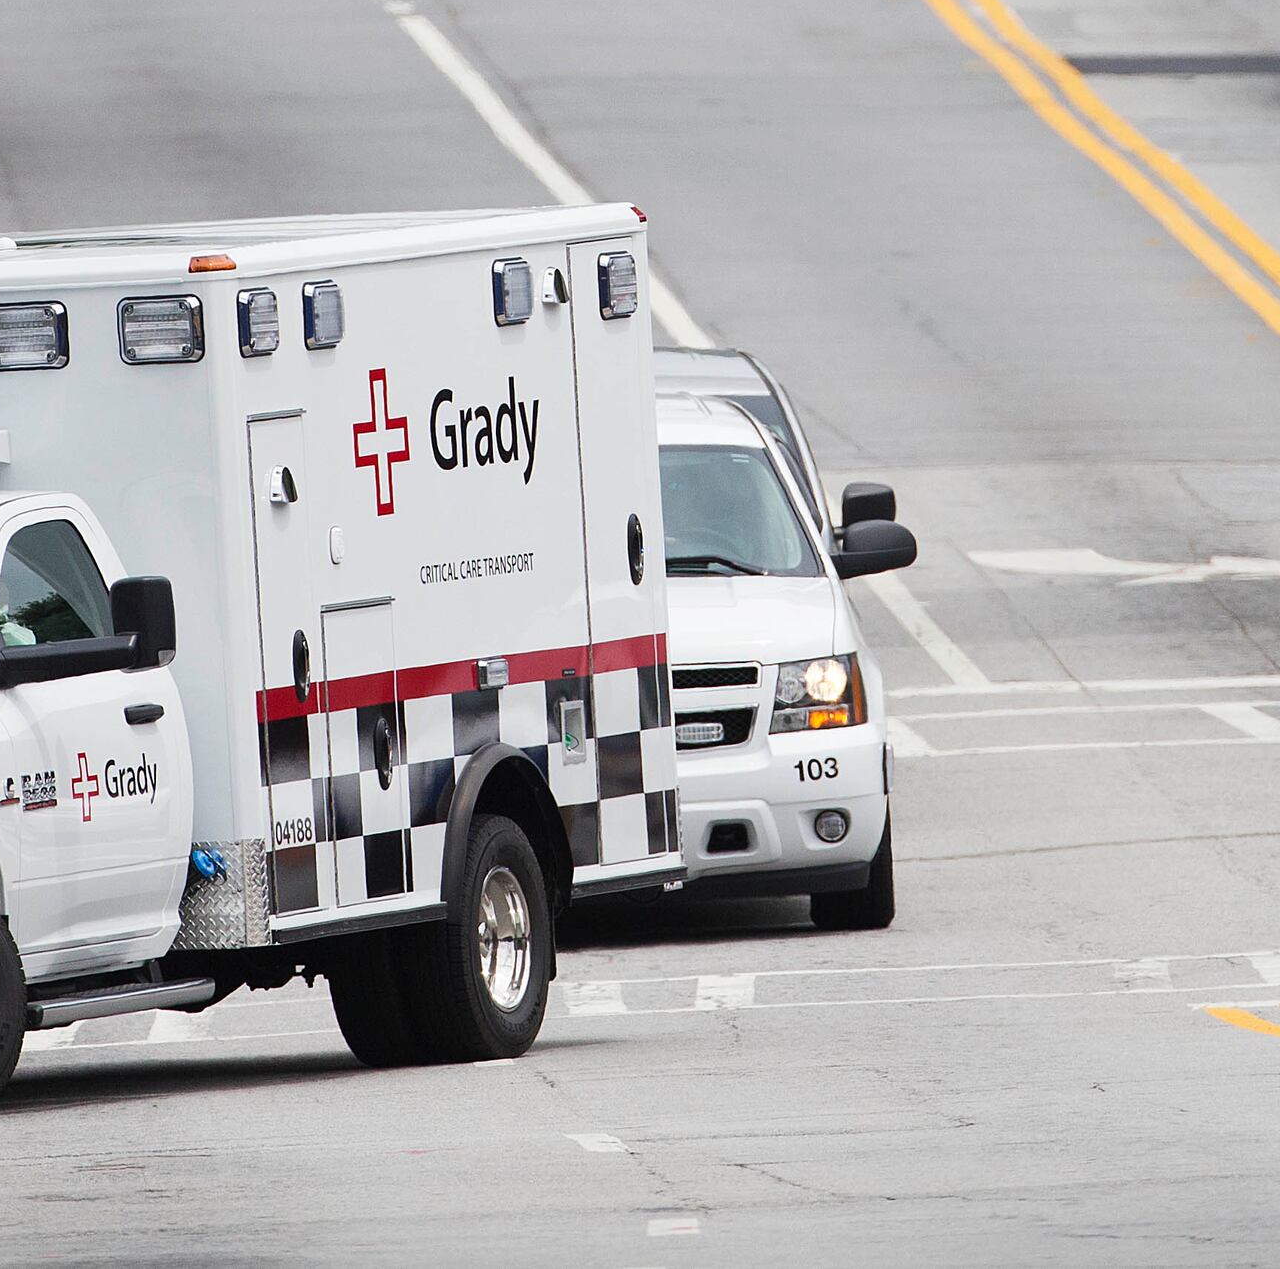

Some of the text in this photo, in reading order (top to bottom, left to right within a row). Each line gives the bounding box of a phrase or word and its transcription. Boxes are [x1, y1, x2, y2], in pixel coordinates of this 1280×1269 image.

[429, 376, 540, 485] Grady
[419, 552, 534, 585] CRITICAL CARE TRANSPORT
[104, 752, 157, 805] Grady
[793, 757, 839, 782] 103
[275, 816, 313, 845] 04188
